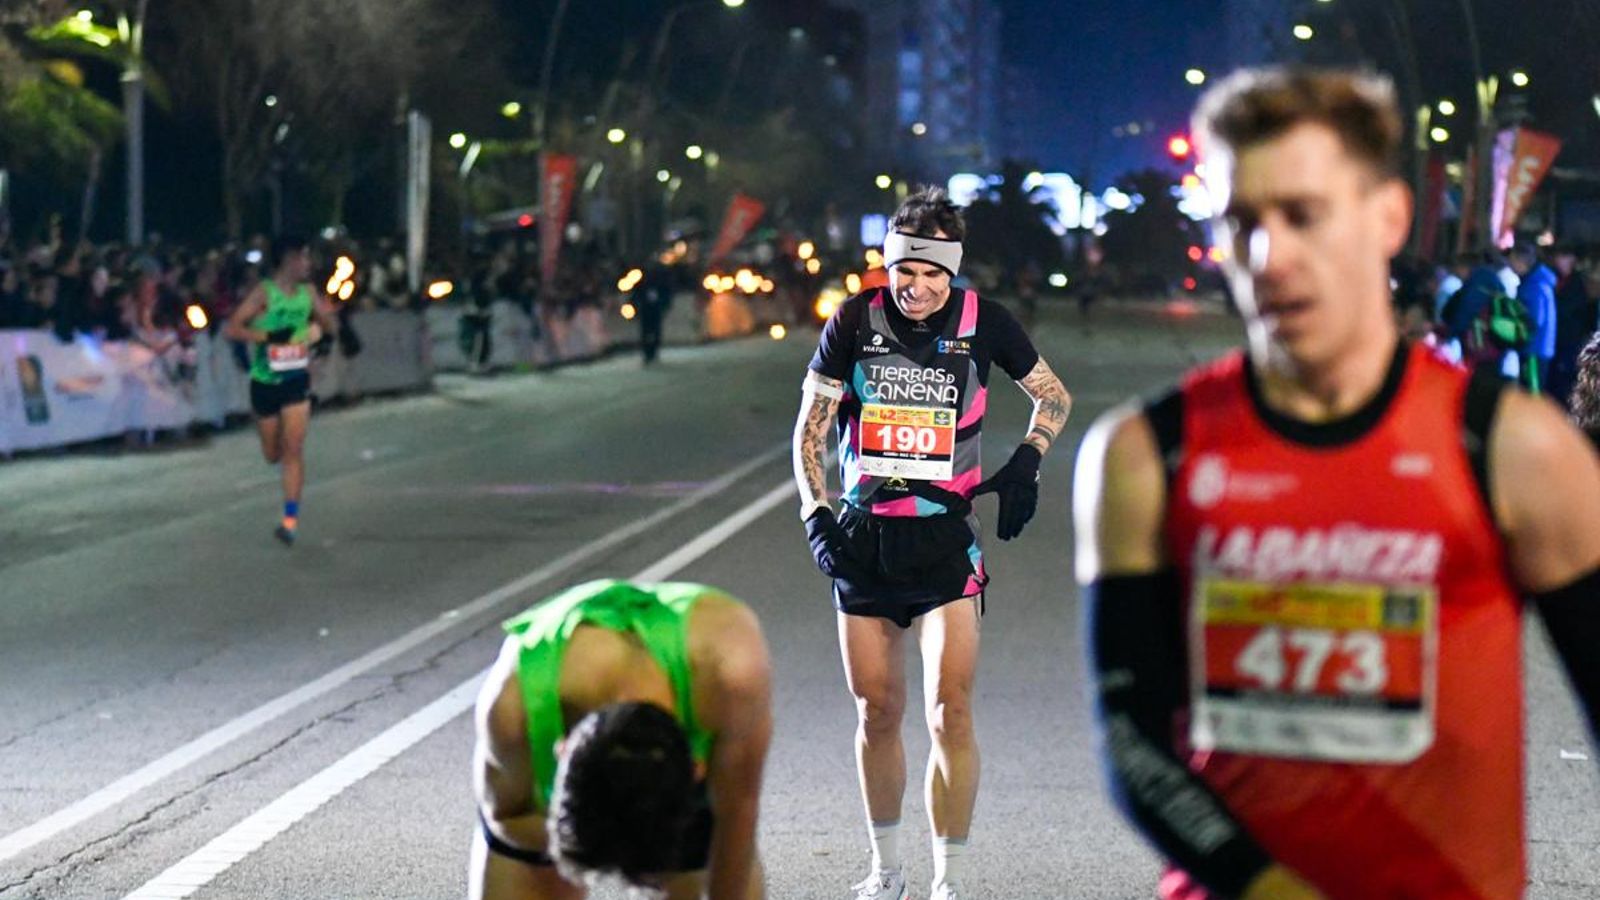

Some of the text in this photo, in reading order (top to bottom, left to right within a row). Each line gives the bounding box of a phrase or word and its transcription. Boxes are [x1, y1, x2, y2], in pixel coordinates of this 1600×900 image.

[863, 345, 890, 354] VIATOR
[862, 380, 959, 405] CANENA
[877, 425, 936, 452] 190
[1236, 626, 1388, 693] 473
